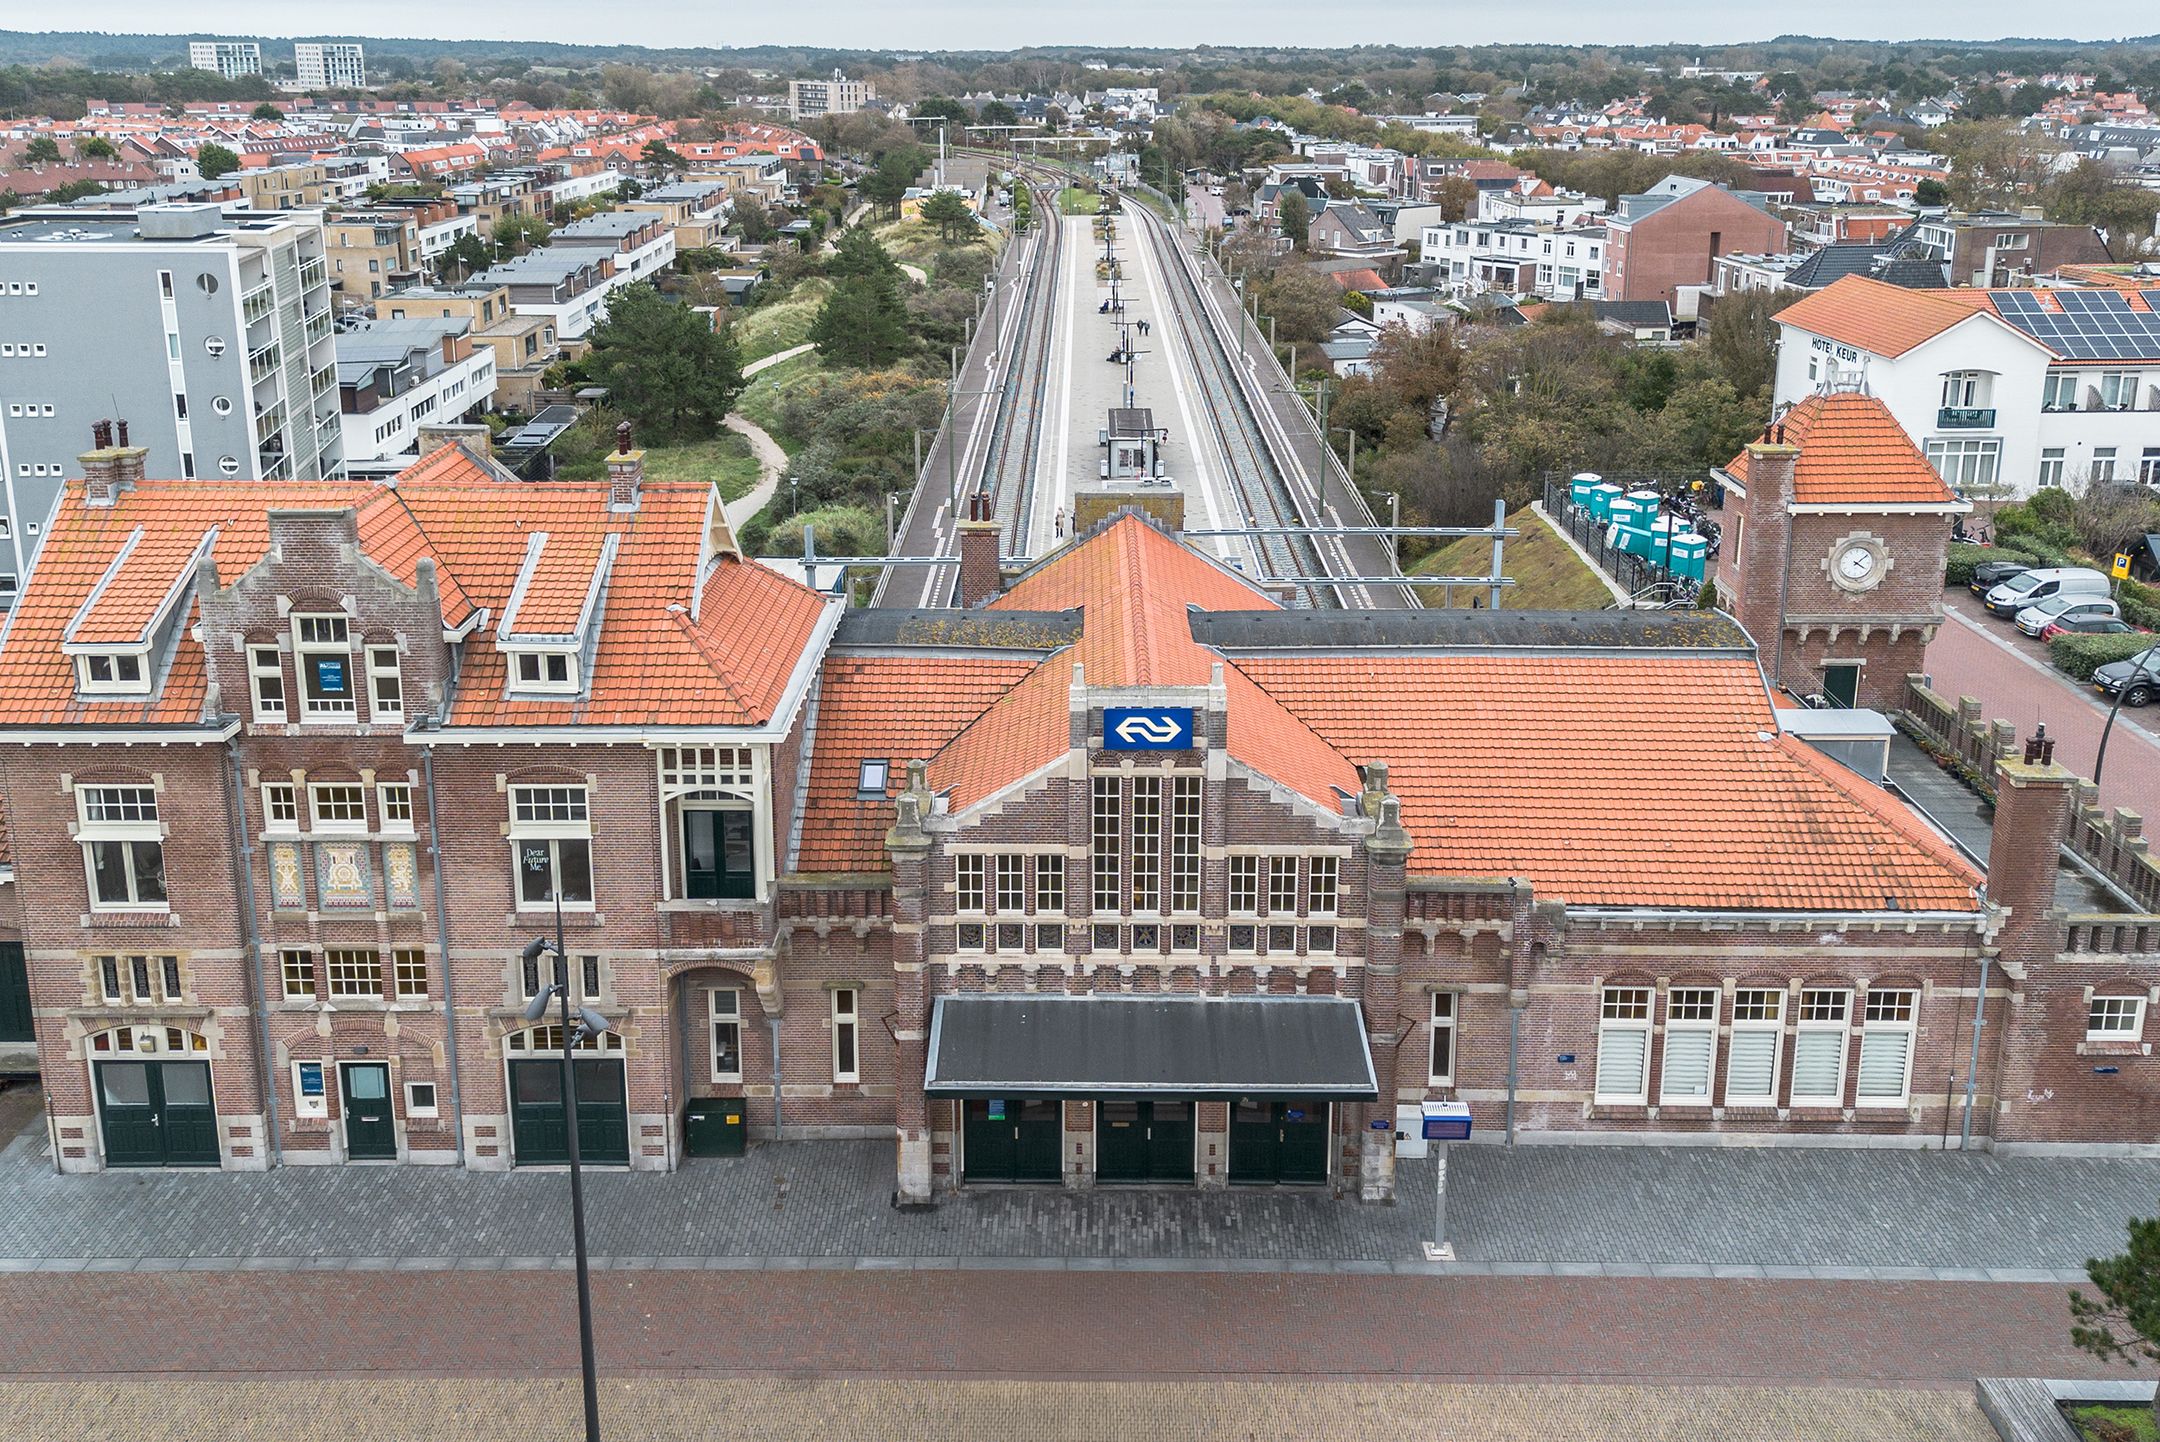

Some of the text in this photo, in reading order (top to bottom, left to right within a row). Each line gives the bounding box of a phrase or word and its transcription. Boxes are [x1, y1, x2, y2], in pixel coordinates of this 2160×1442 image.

[1836, 346, 1857, 363] KEUR
[526, 848, 544, 857] Dear
[523, 856, 549, 864] Future
